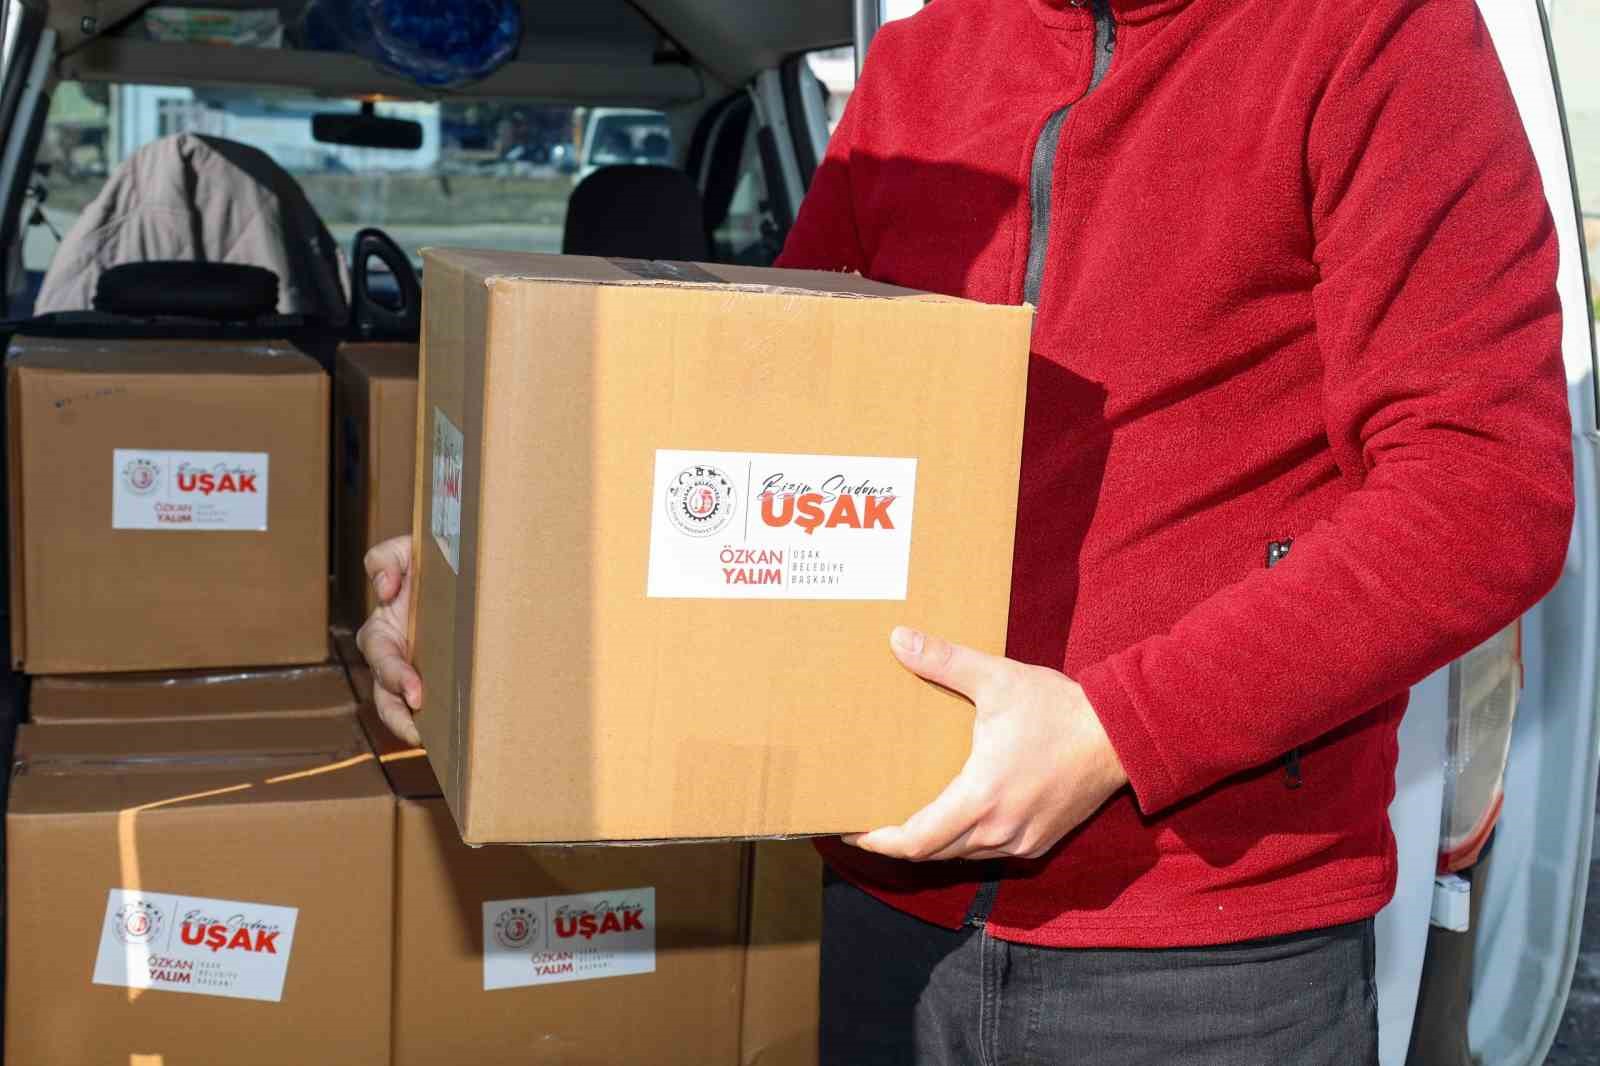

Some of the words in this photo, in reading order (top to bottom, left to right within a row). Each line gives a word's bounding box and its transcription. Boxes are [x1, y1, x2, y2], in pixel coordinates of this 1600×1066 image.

[177, 473, 258, 496] UŞAK
[761, 490, 897, 535] UŞAK
[719, 545, 784, 564] ÖZKAN
[722, 568, 782, 584] YALIM
[555, 910, 645, 940] UŞAK
[180, 921, 281, 954] UŞAK
[147, 954, 193, 970] ÖZKAN
[531, 950, 574, 965] ÖZKAN
[148, 968, 192, 984] YALIM
[533, 962, 574, 976] YALIM
